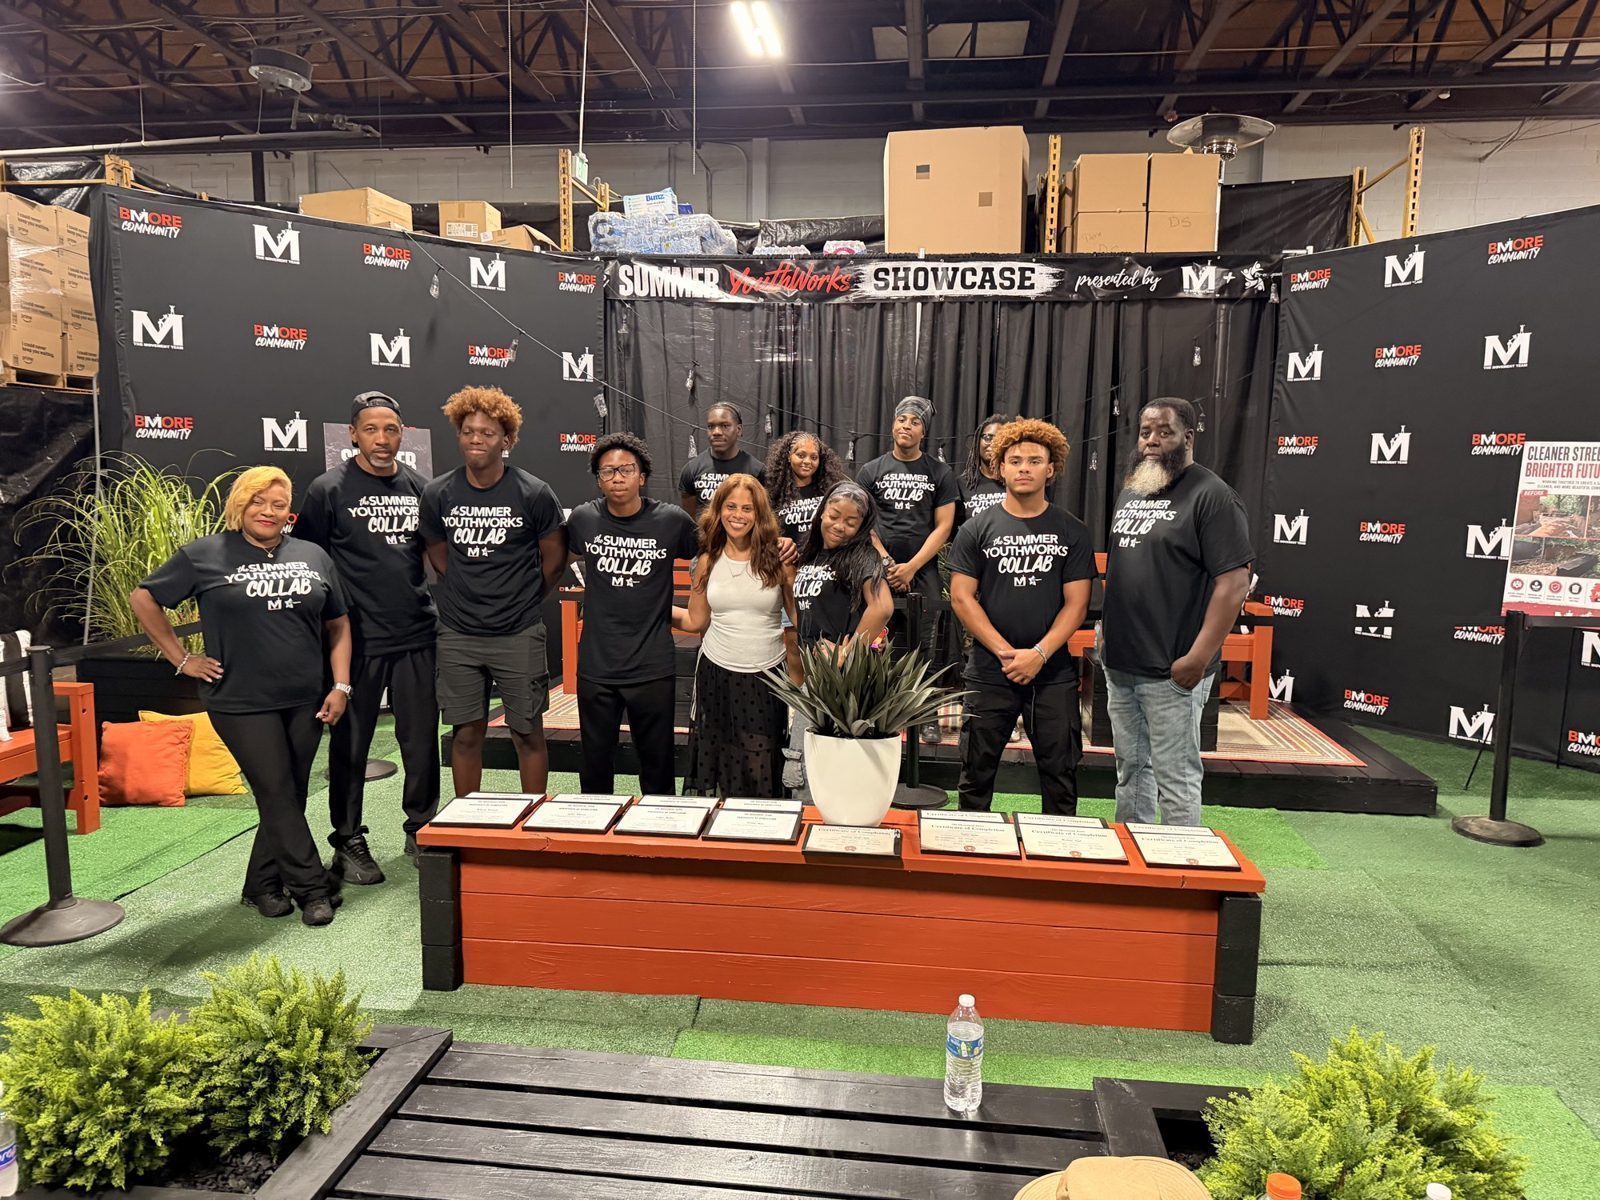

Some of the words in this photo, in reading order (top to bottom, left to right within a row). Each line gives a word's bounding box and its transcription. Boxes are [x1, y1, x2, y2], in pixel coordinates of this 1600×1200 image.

[119, 206, 182, 228] BMORE
[1488, 235, 1544, 254] BMORE
[363, 244, 412, 260] BMORE
[558, 272, 596, 284] BMORE
[619, 264, 720, 299] SUMMER
[728, 261, 851, 294] YouthWorks
[873, 266, 1036, 292] SHOWCASE
[1075, 269, 1138, 292] presented
[1142, 266, 1162, 291] by
[1290, 268, 1331, 282] BMORE
[254, 324, 308, 340] BMORE
[1375, 344, 1422, 359] BMORE
[135, 414, 194, 428] BMORE
[560, 432, 596, 445] BMORE
[1278, 434, 1318, 446] BMORE
[1472, 432, 1526, 446] BMORE
[1528, 446, 1570, 461] CLEANER
[1525, 462, 1574, 478] BRIGHTER
[889, 474, 928, 482] SUMMER
[876, 482, 936, 491] YOUTHWORKS
[369, 496, 418, 506] SUMMER
[884, 488, 924, 501] COLLAB
[459, 506, 511, 517] SUMMER
[1130, 500, 1171, 509] SUMMER
[442, 516, 523, 528] YOUTHWORKS
[1115, 510, 1177, 520] YOUTHWORKS
[368, 516, 420, 532] COLLAB
[1112, 520, 1156, 535] COLLAB
[1360, 521, 1406, 534] BMORE
[454, 528, 506, 545] COLLAB
[604, 536, 656, 549] SUMMER
[1003, 534, 1058, 546] SUMMER
[584, 542, 667, 558] YOUTHWORKS
[982, 545, 1068, 558] YOUTHWORKS
[248, 562, 309, 573] SUMMER
[596, 557, 652, 576] COLLAB
[998, 556, 1052, 574] COLLAB
[224, 569, 320, 584] YOUTHWORKS
[246, 580, 312, 598] COLLAB
[1264, 595, 1304, 610] BMORE
[1454, 630, 1504, 644] COMMUNITY
[1344, 689, 1390, 707] BMORE
